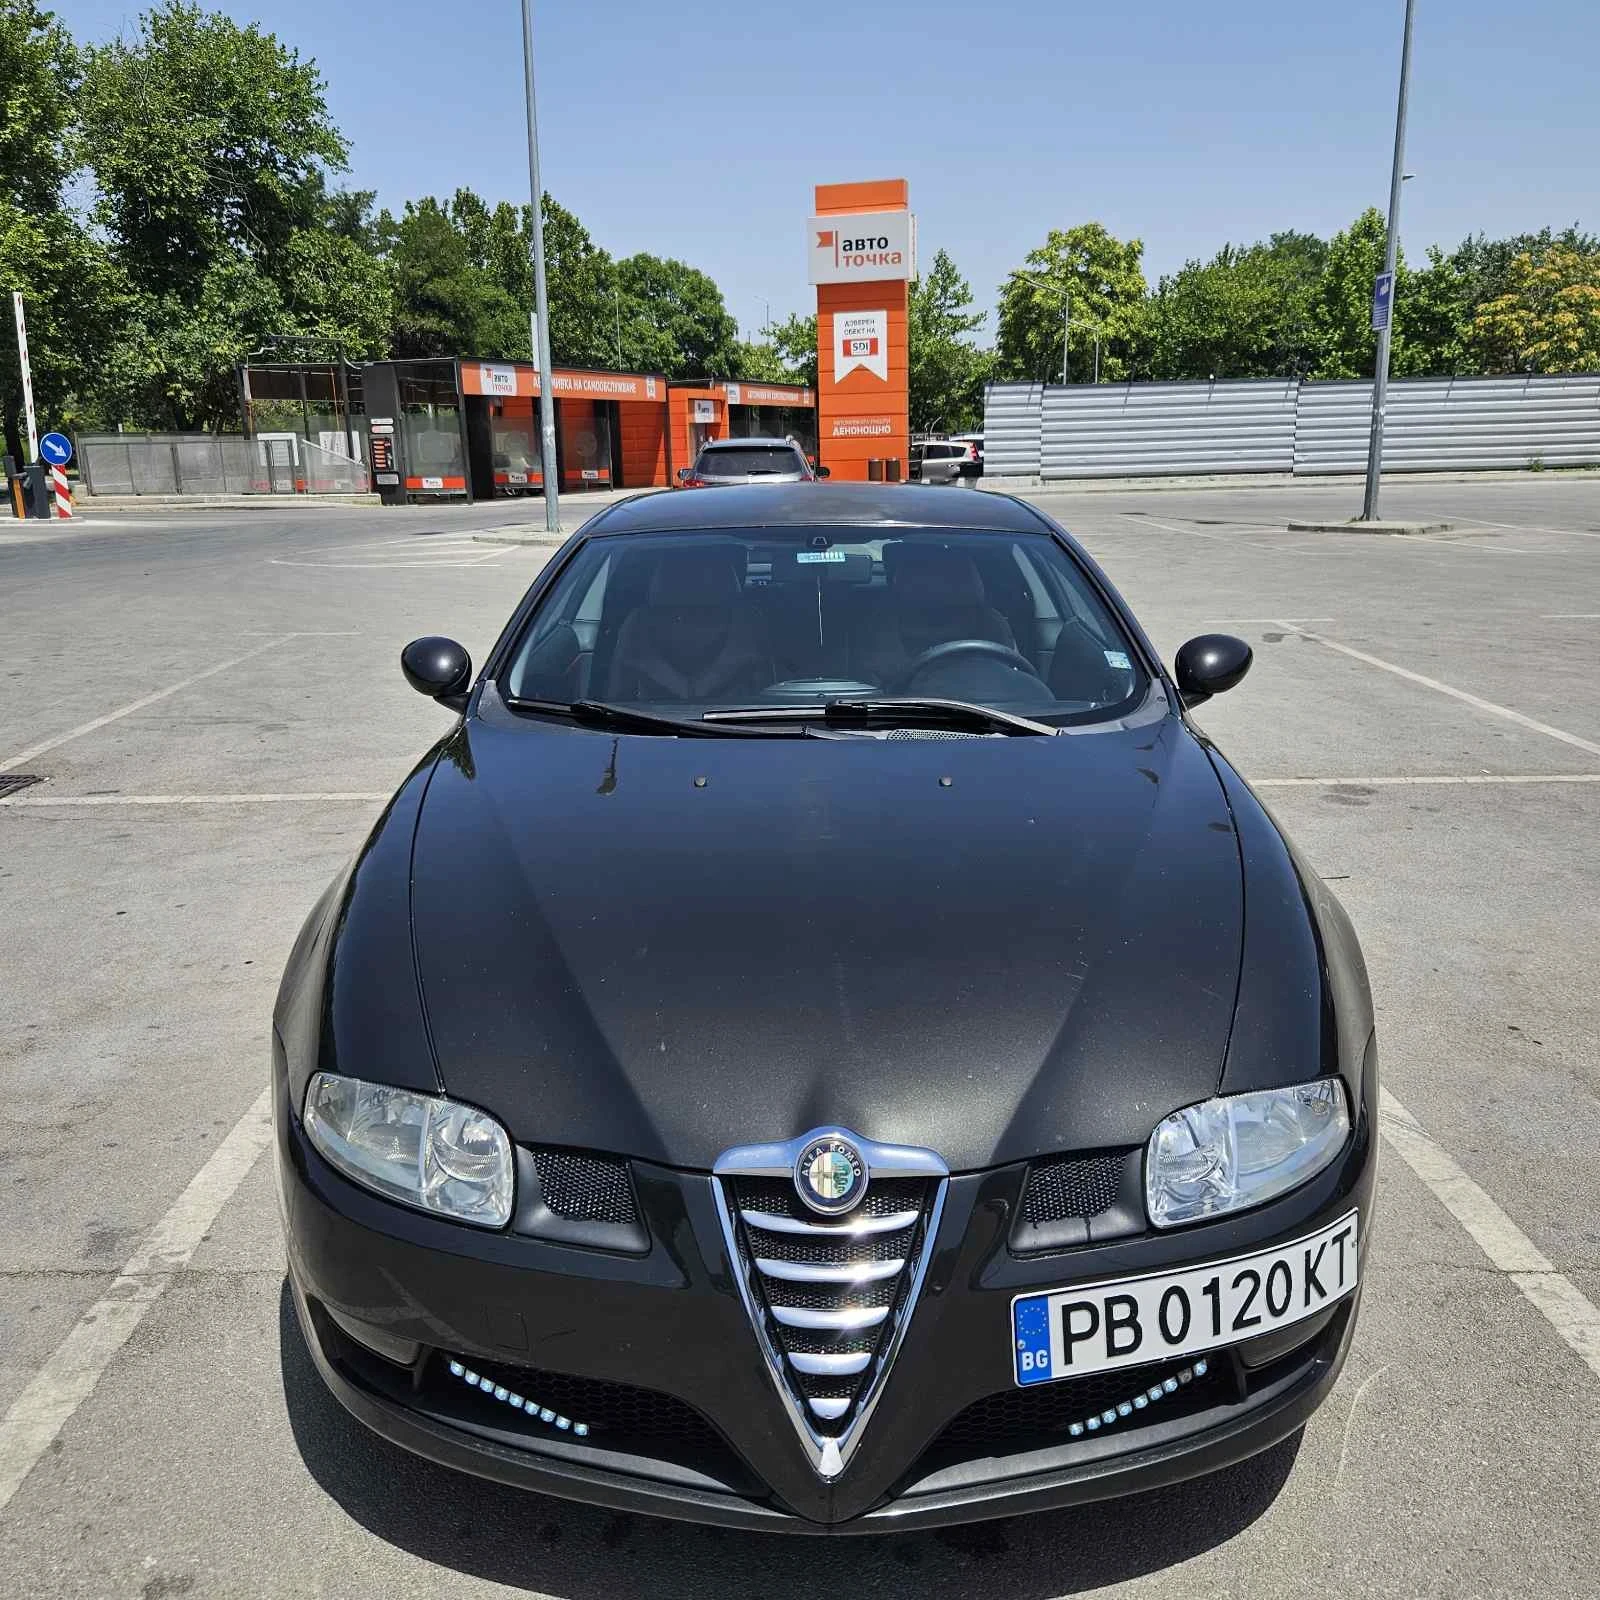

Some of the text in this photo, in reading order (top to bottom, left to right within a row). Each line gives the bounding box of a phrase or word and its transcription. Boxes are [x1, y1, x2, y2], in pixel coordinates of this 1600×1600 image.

[842, 237, 889, 251] авто
[843, 252, 902, 268] точка
[852, 342, 869, 352] SDI
[801, 1143, 861, 1177] ALFA ROMEO
[1061, 1225, 1353, 1366] PB 0120 KT
[1021, 1350, 1048, 1372] BG
